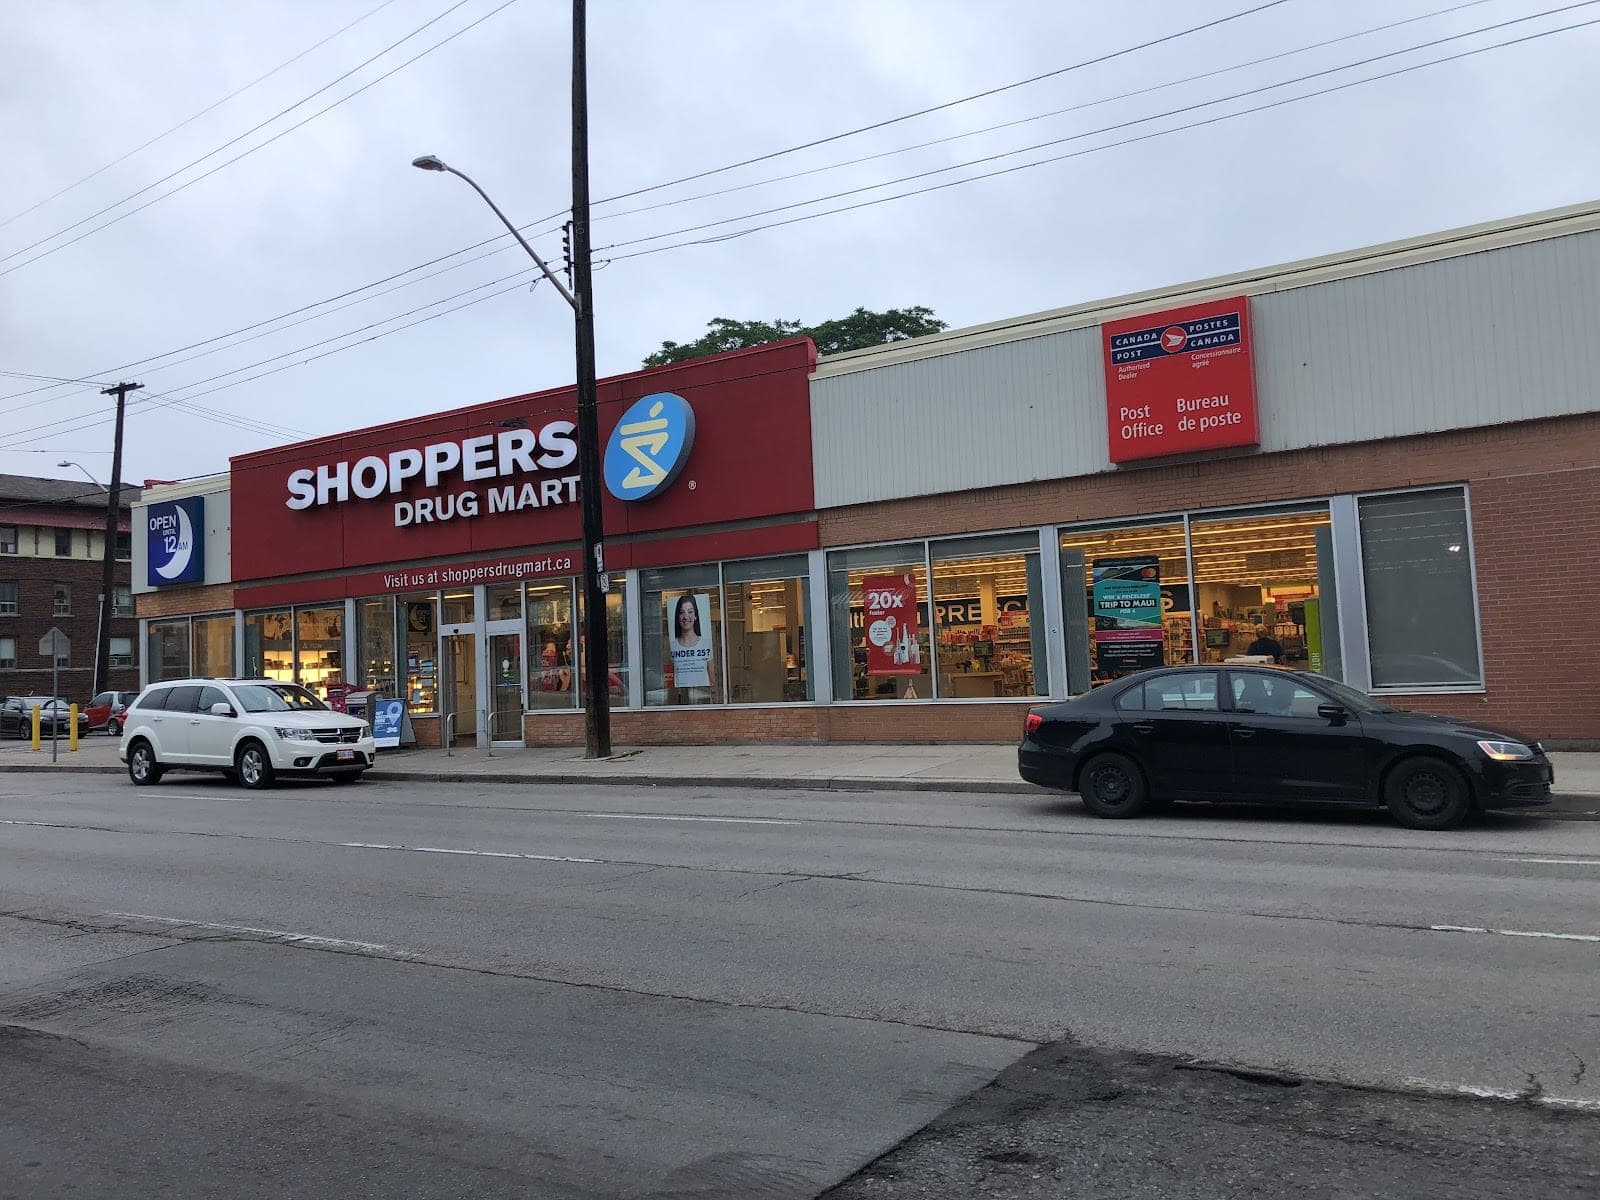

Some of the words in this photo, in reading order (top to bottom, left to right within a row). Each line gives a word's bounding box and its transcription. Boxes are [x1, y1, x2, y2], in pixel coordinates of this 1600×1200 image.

[1189, 319, 1228, 332] POSTES
[1116, 332, 1158, 346] CANADA
[1190, 333, 1235, 347] CANADA
[1117, 350, 1142, 360] POST
[1191, 348, 1241, 361] Concessionnaire
[1118, 362, 1150, 373] Authorized
[1191, 360, 1210, 369] agréé
[1118, 372, 1137, 380] Dealer
[1176, 394, 1229, 412] Bureau
[1120, 404, 1151, 421] Post
[1178, 415, 1196, 431] de
[1200, 411, 1242, 432] poste
[1121, 422, 1164, 439] Office
[285, 421, 578, 510] SHOPPERS
[394, 491, 479, 527] DRUG
[488, 475, 580, 514] MART
[150, 515, 177, 530] OPEN
[164, 536, 177, 553] 12
[178, 541, 188, 551] AM
[384, 572, 408, 589] Visit
[412, 573, 425, 585] us
[427, 570, 438, 584] at
[442, 557, 571, 583] shoppersdrugmart.ca
[868, 591, 904, 609] 20x
[1132, 599, 1155, 607] MAUI
[671, 650, 695, 658] UNDER
[696, 648, 711, 657] 25?
